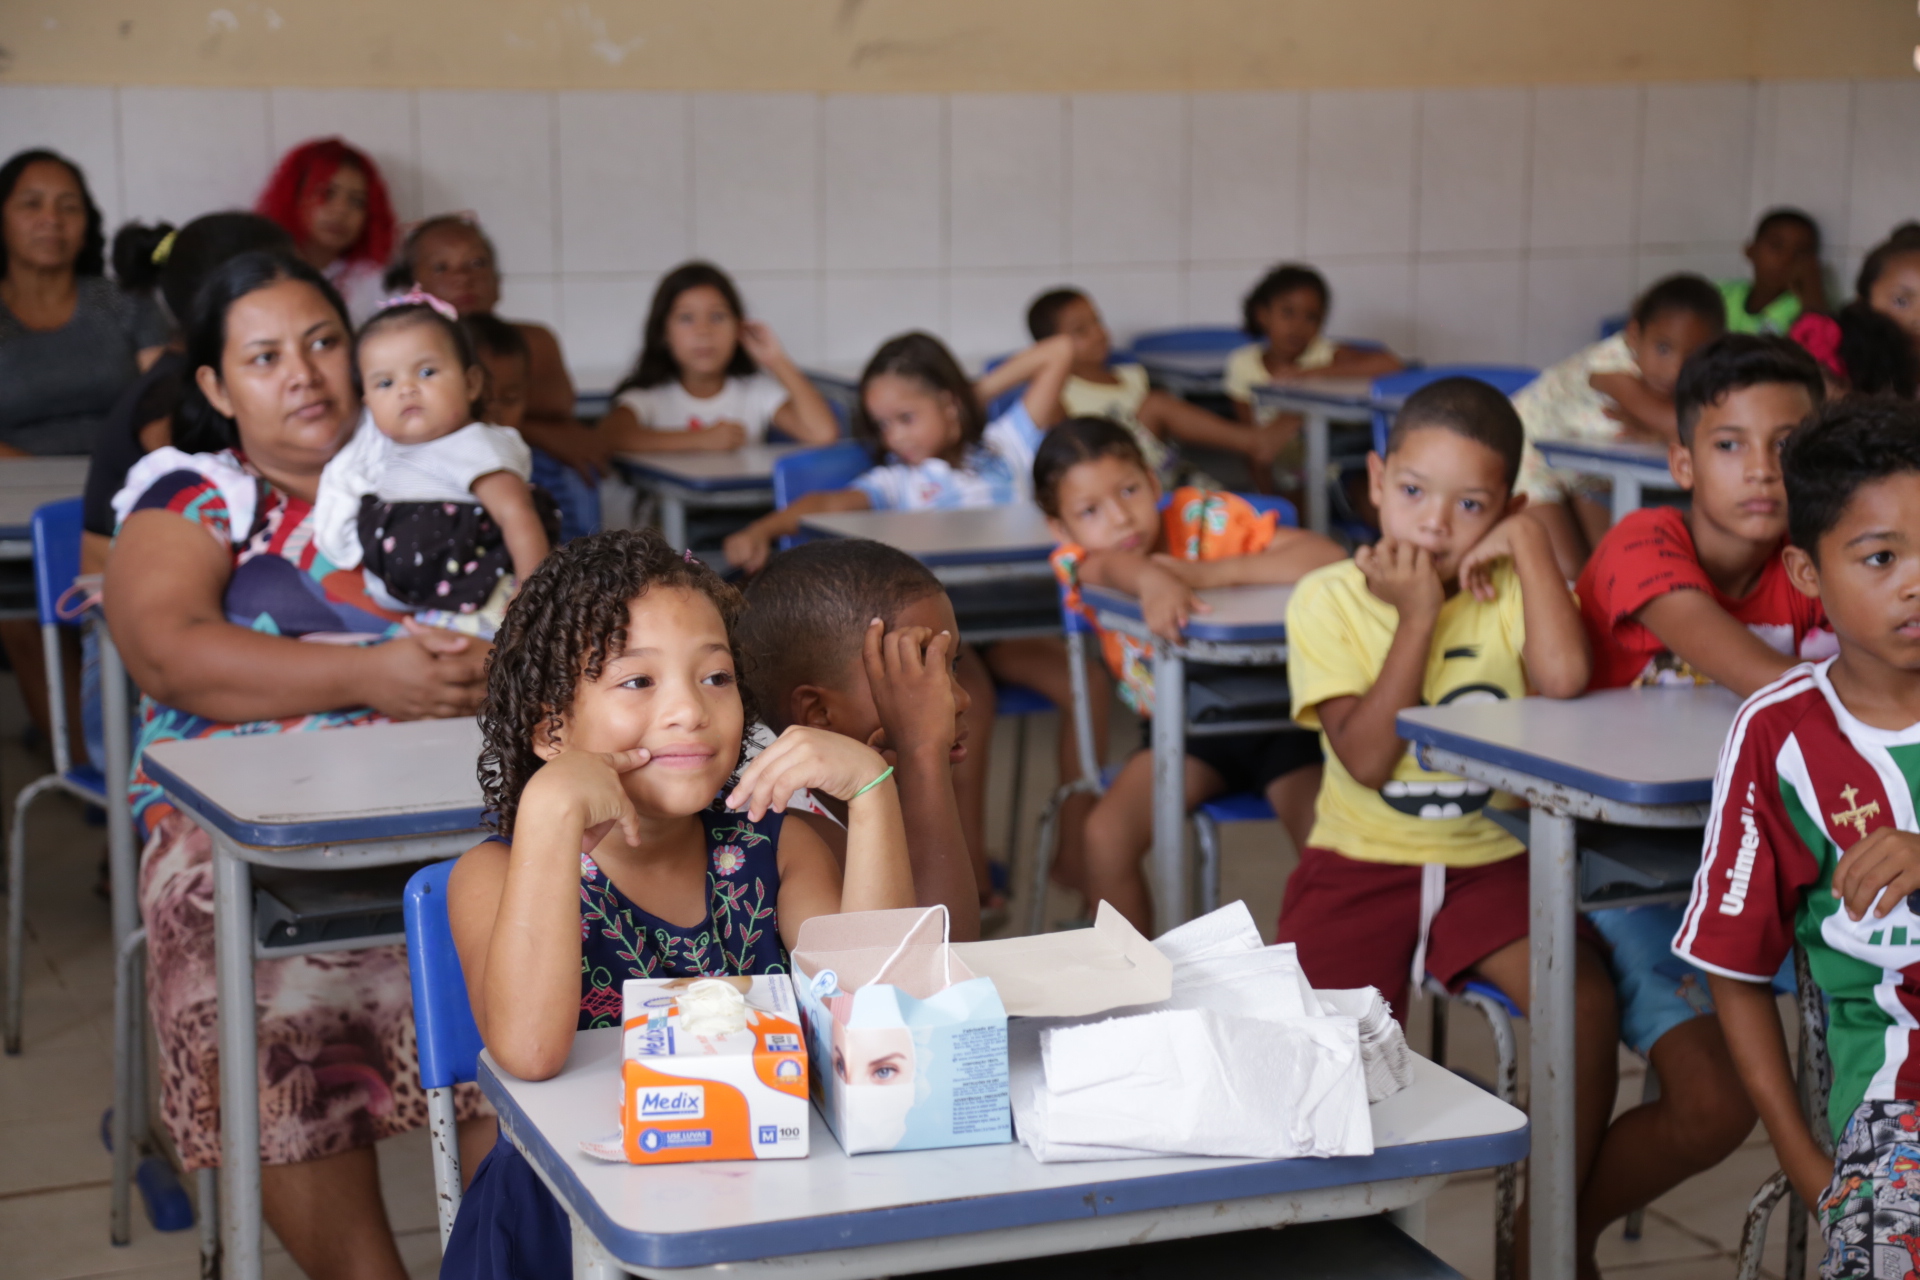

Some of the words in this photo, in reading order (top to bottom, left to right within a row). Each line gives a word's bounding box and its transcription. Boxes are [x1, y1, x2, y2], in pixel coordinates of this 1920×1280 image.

[1719, 812, 1760, 917] Unimed
[642, 1091, 700, 1111] Medix
[666, 1131, 681, 1140] USE
[683, 1130, 707, 1139] LUVAS
[762, 1131, 775, 1142] M
[779, 1127, 800, 1137] 100
